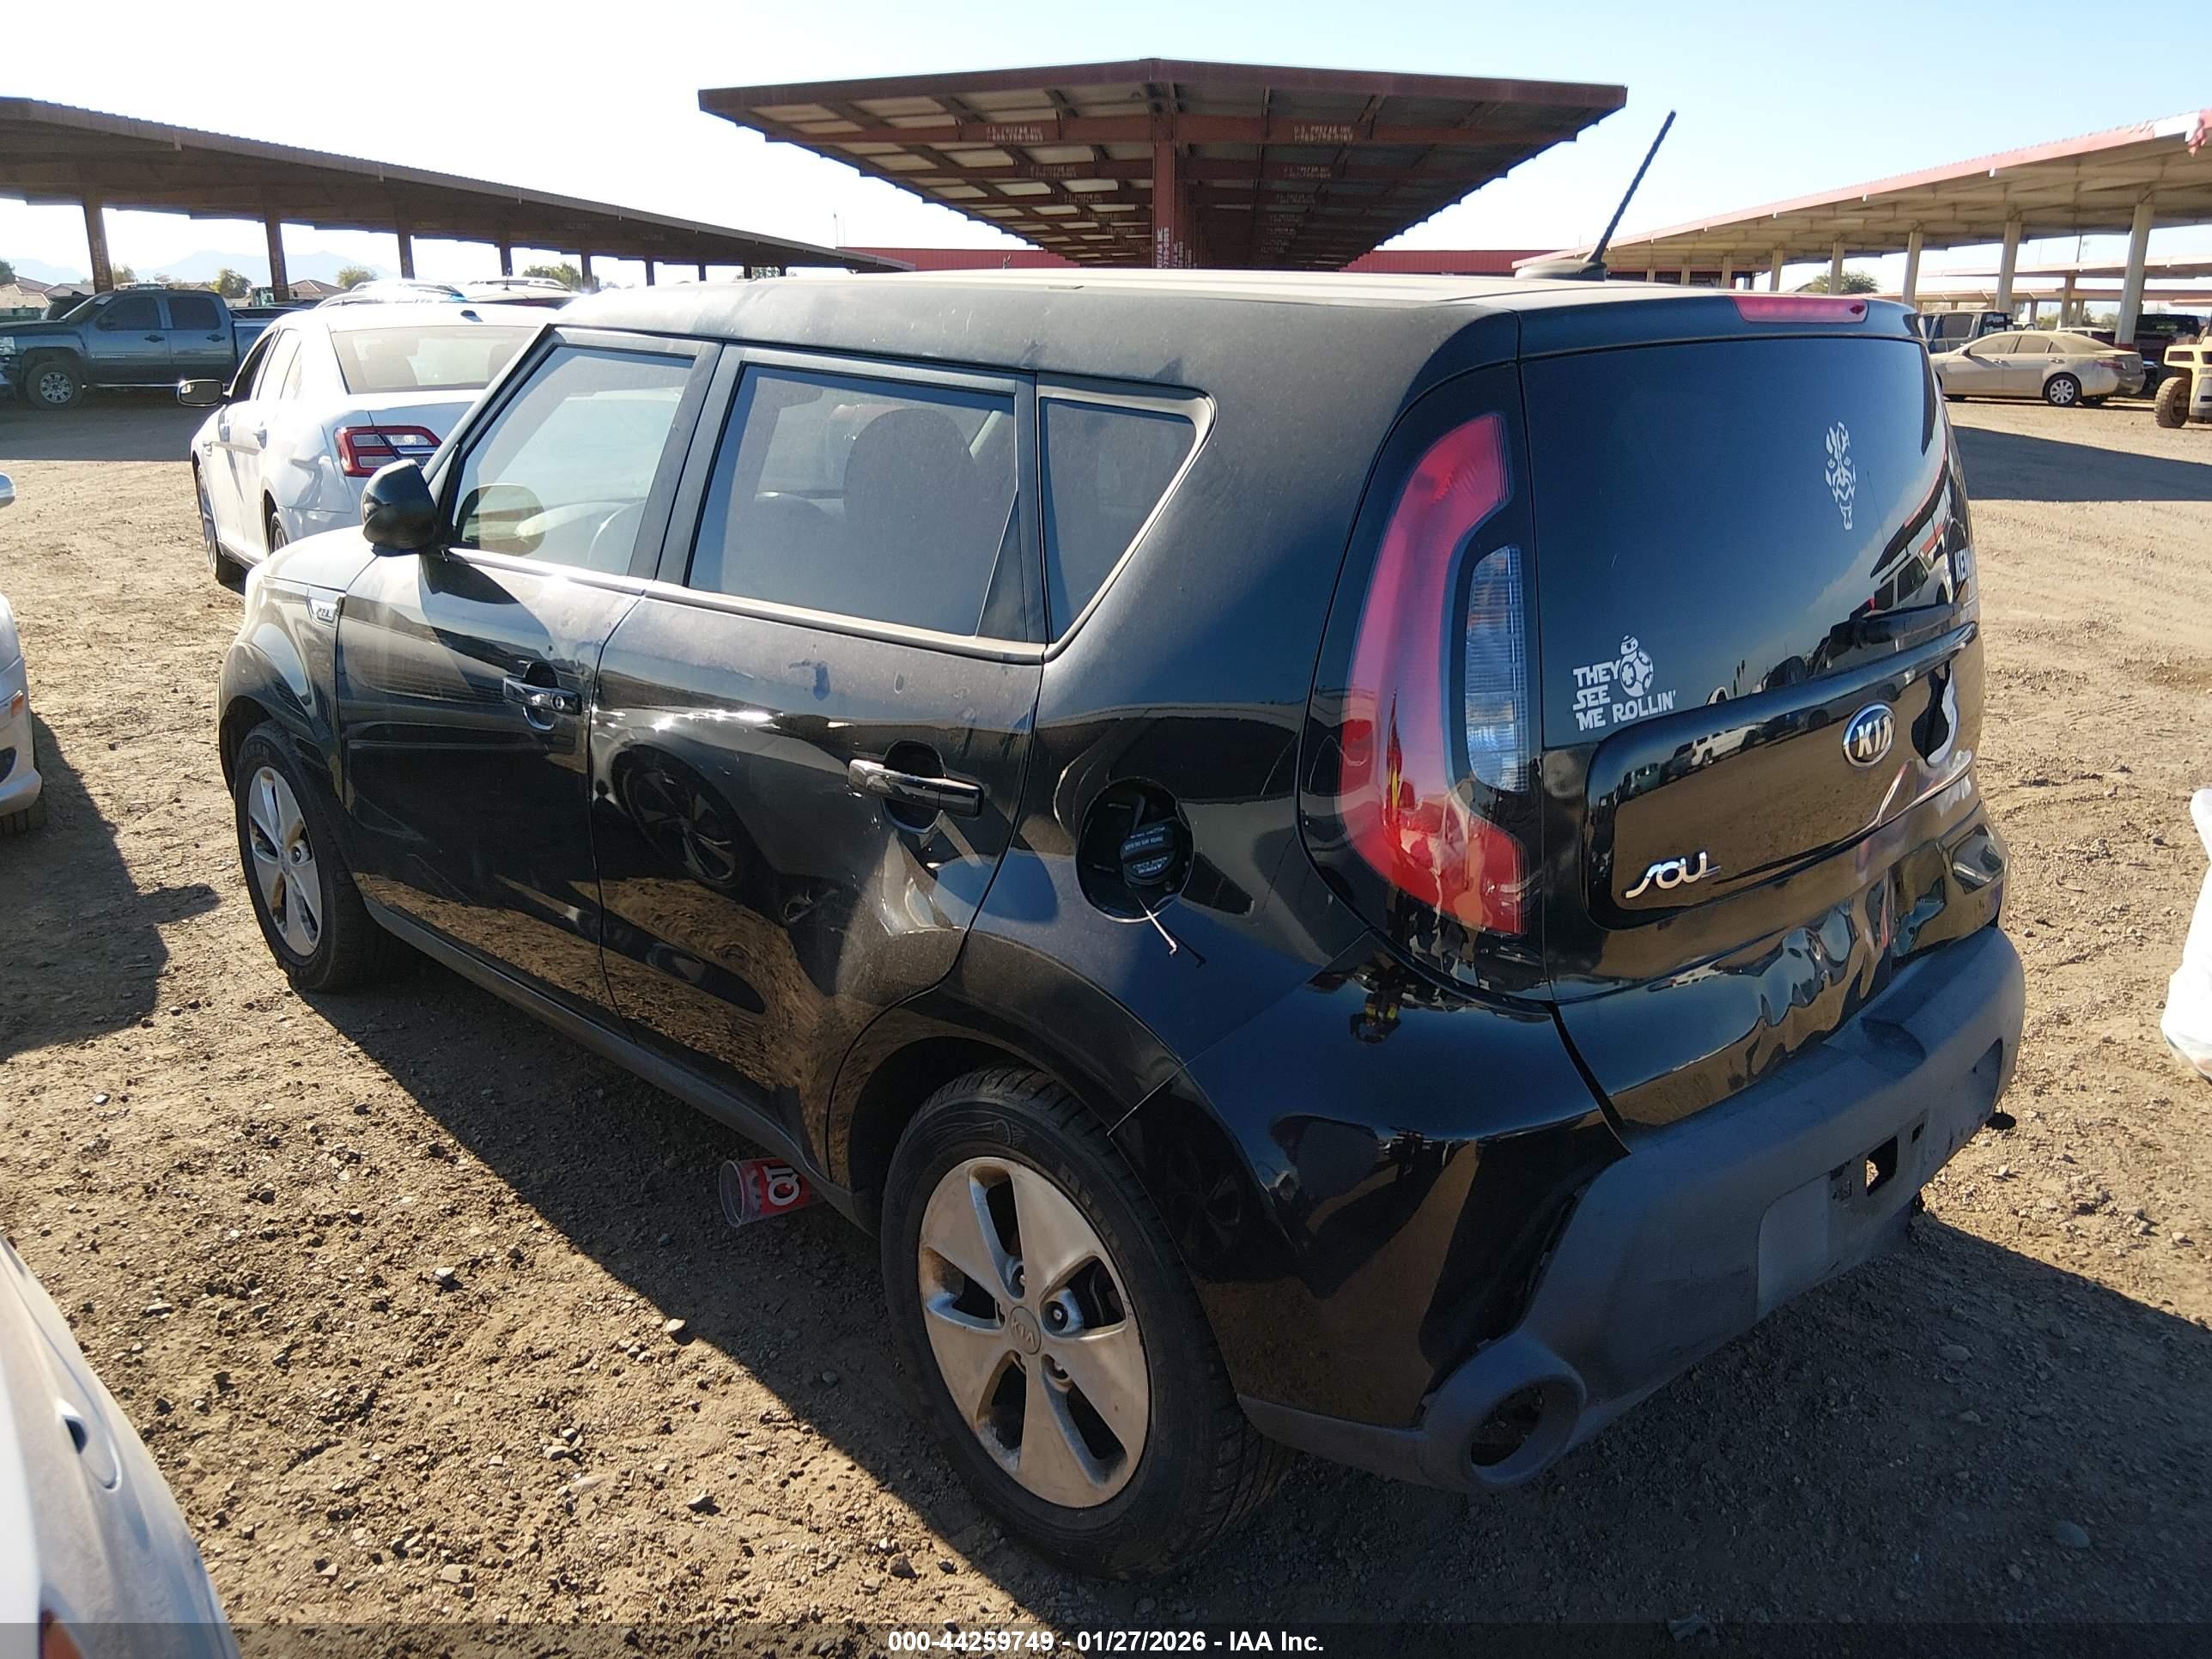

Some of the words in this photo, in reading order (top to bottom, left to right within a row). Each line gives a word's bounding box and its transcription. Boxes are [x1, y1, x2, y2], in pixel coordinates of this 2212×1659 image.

[1572, 659, 1621, 687] THEY
[1572, 684, 1610, 711] SEE
[1576, 707, 1606, 731] ME
[1612, 690, 1675, 723] ROLLIN'
[1856, 715, 1893, 757] KIA
[1012, 1317, 1036, 1347] KIA
